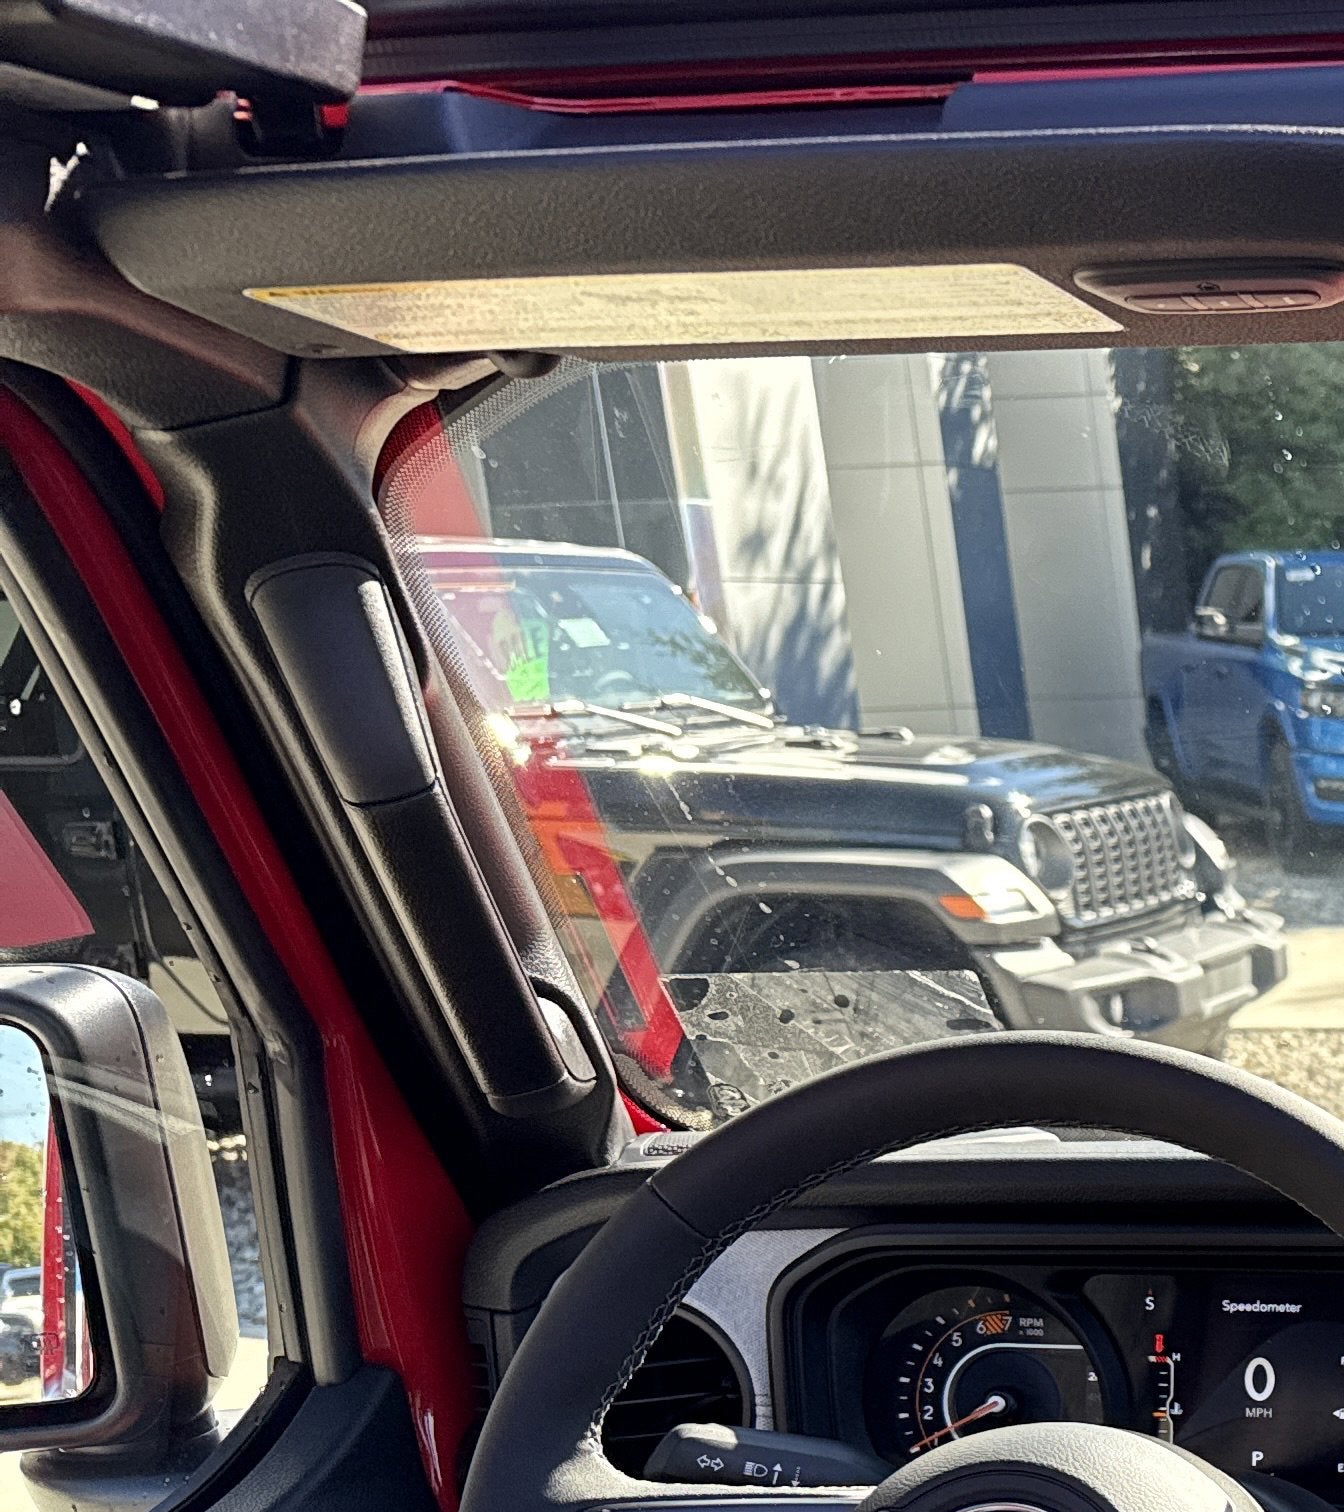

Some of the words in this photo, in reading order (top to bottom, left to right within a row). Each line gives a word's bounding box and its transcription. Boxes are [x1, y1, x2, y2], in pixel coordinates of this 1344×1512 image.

[1145, 1297, 1155, 1311] S
[1222, 1300, 1302, 1314] Speedometer
[976, 1321, 986, 1334] 6
[1003, 1316, 1013, 1331] 7
[1019, 1317, 1044, 1327] RPM
[951, 1332, 962, 1347] 5
[932, 1352, 943, 1367] 4
[1172, 1353, 1181, 1362] H
[923, 1378, 934, 1393] 3
[1244, 1357, 1276, 1402] 0
[923, 1406, 934, 1421] 2
[1245, 1408, 1273, 1418] MPH
[1252, 1451, 1264, 1467] P
[1338, 1463, 1344, 1473] E
